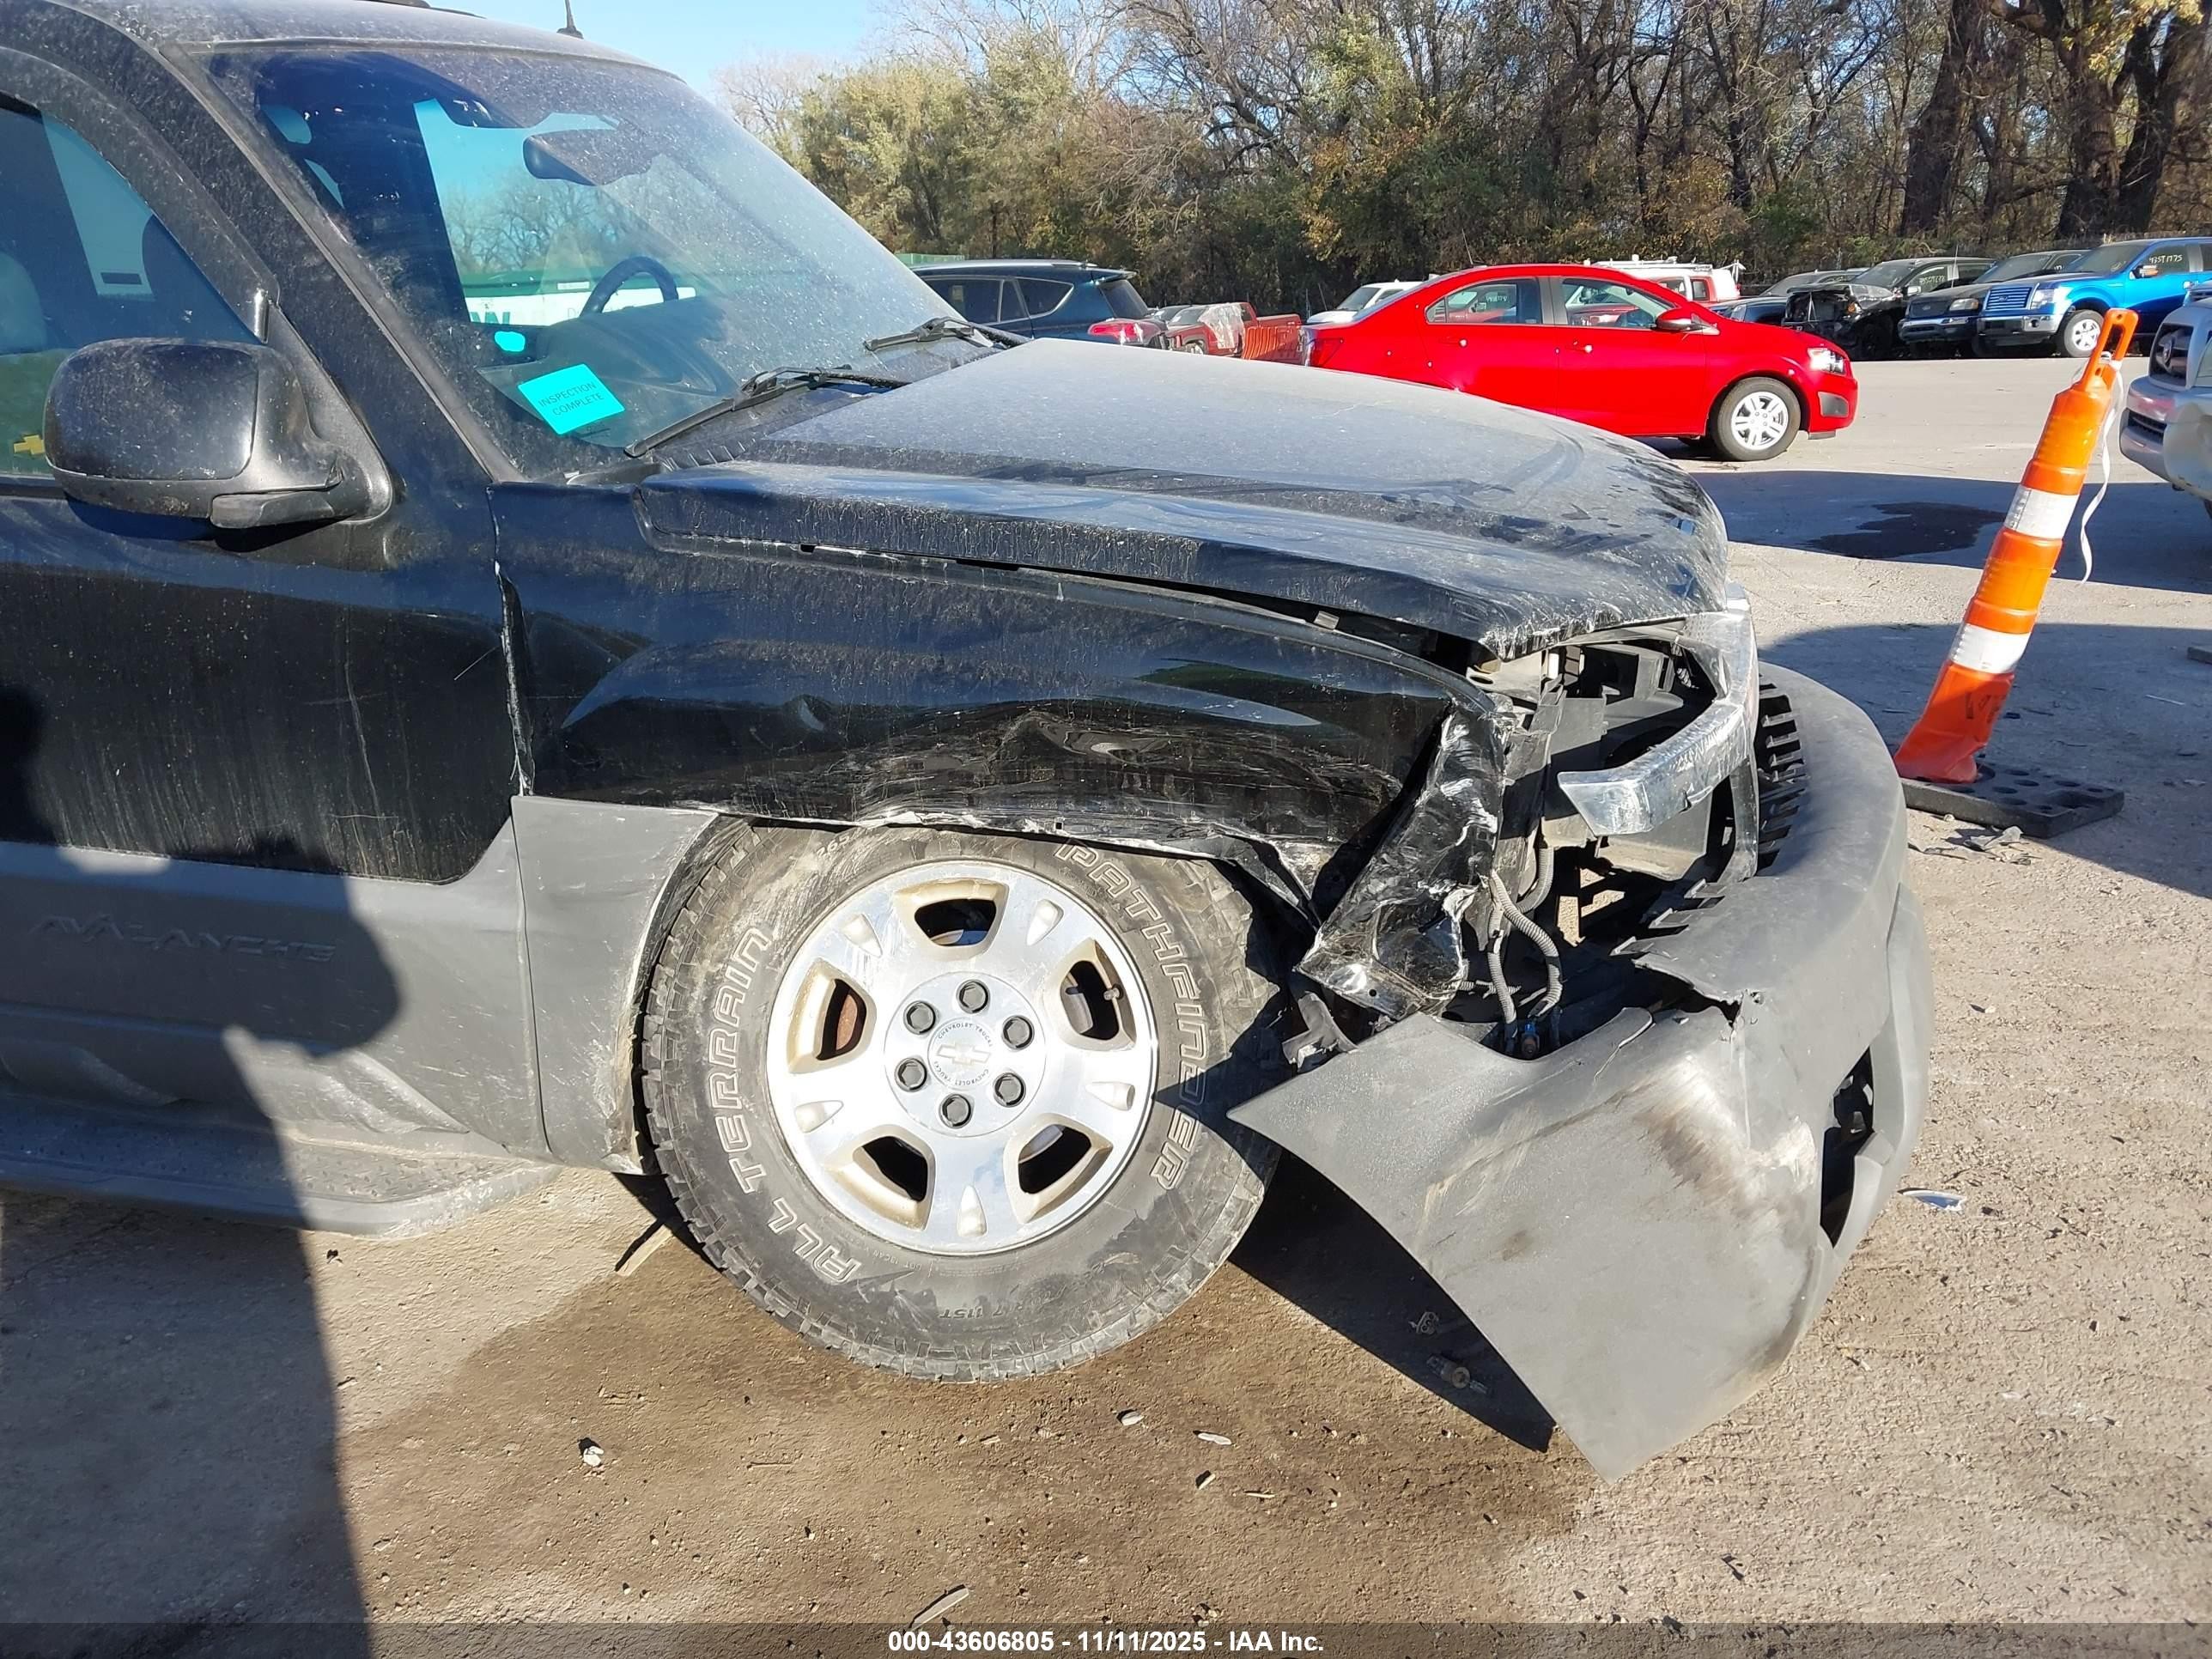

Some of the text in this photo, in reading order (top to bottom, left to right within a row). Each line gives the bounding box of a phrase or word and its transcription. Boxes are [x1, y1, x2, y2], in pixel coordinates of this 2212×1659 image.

[538, 381, 597, 407] INSPECTION
[552, 392, 604, 416] COMPLETE
[28, 914, 336, 963] AVALANCHE
[938, 1023, 973, 1039] CHEVROLET
[1053, 838, 1207, 1190] PATHFINDER
[708, 927, 862, 1284] ALL TERRAIN
